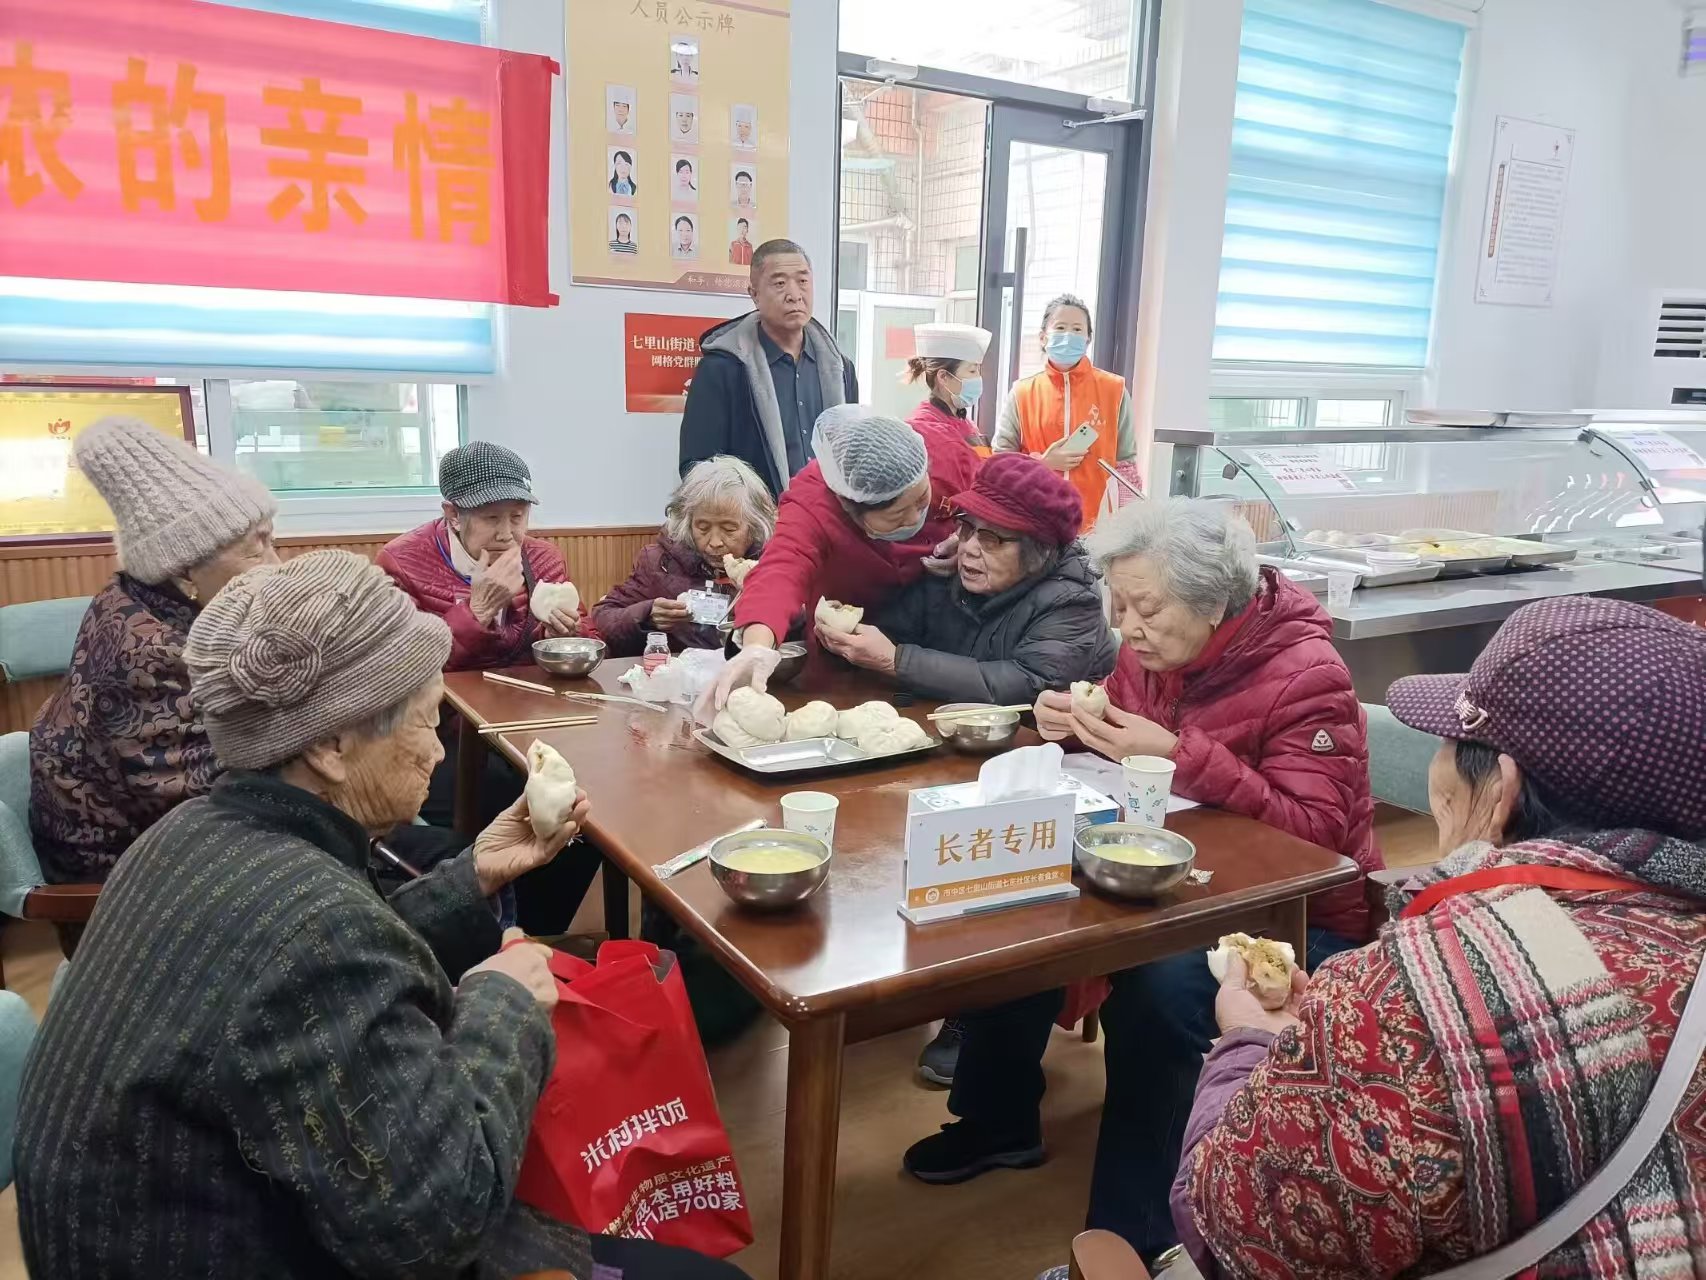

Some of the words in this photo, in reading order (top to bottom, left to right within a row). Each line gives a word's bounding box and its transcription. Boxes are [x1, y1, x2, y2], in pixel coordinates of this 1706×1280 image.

[630, 0, 736, 34] 人员公示牌
[935, 819, 1056, 866] 长者专用
[579, 1097, 689, 1174] 米村拌饭
